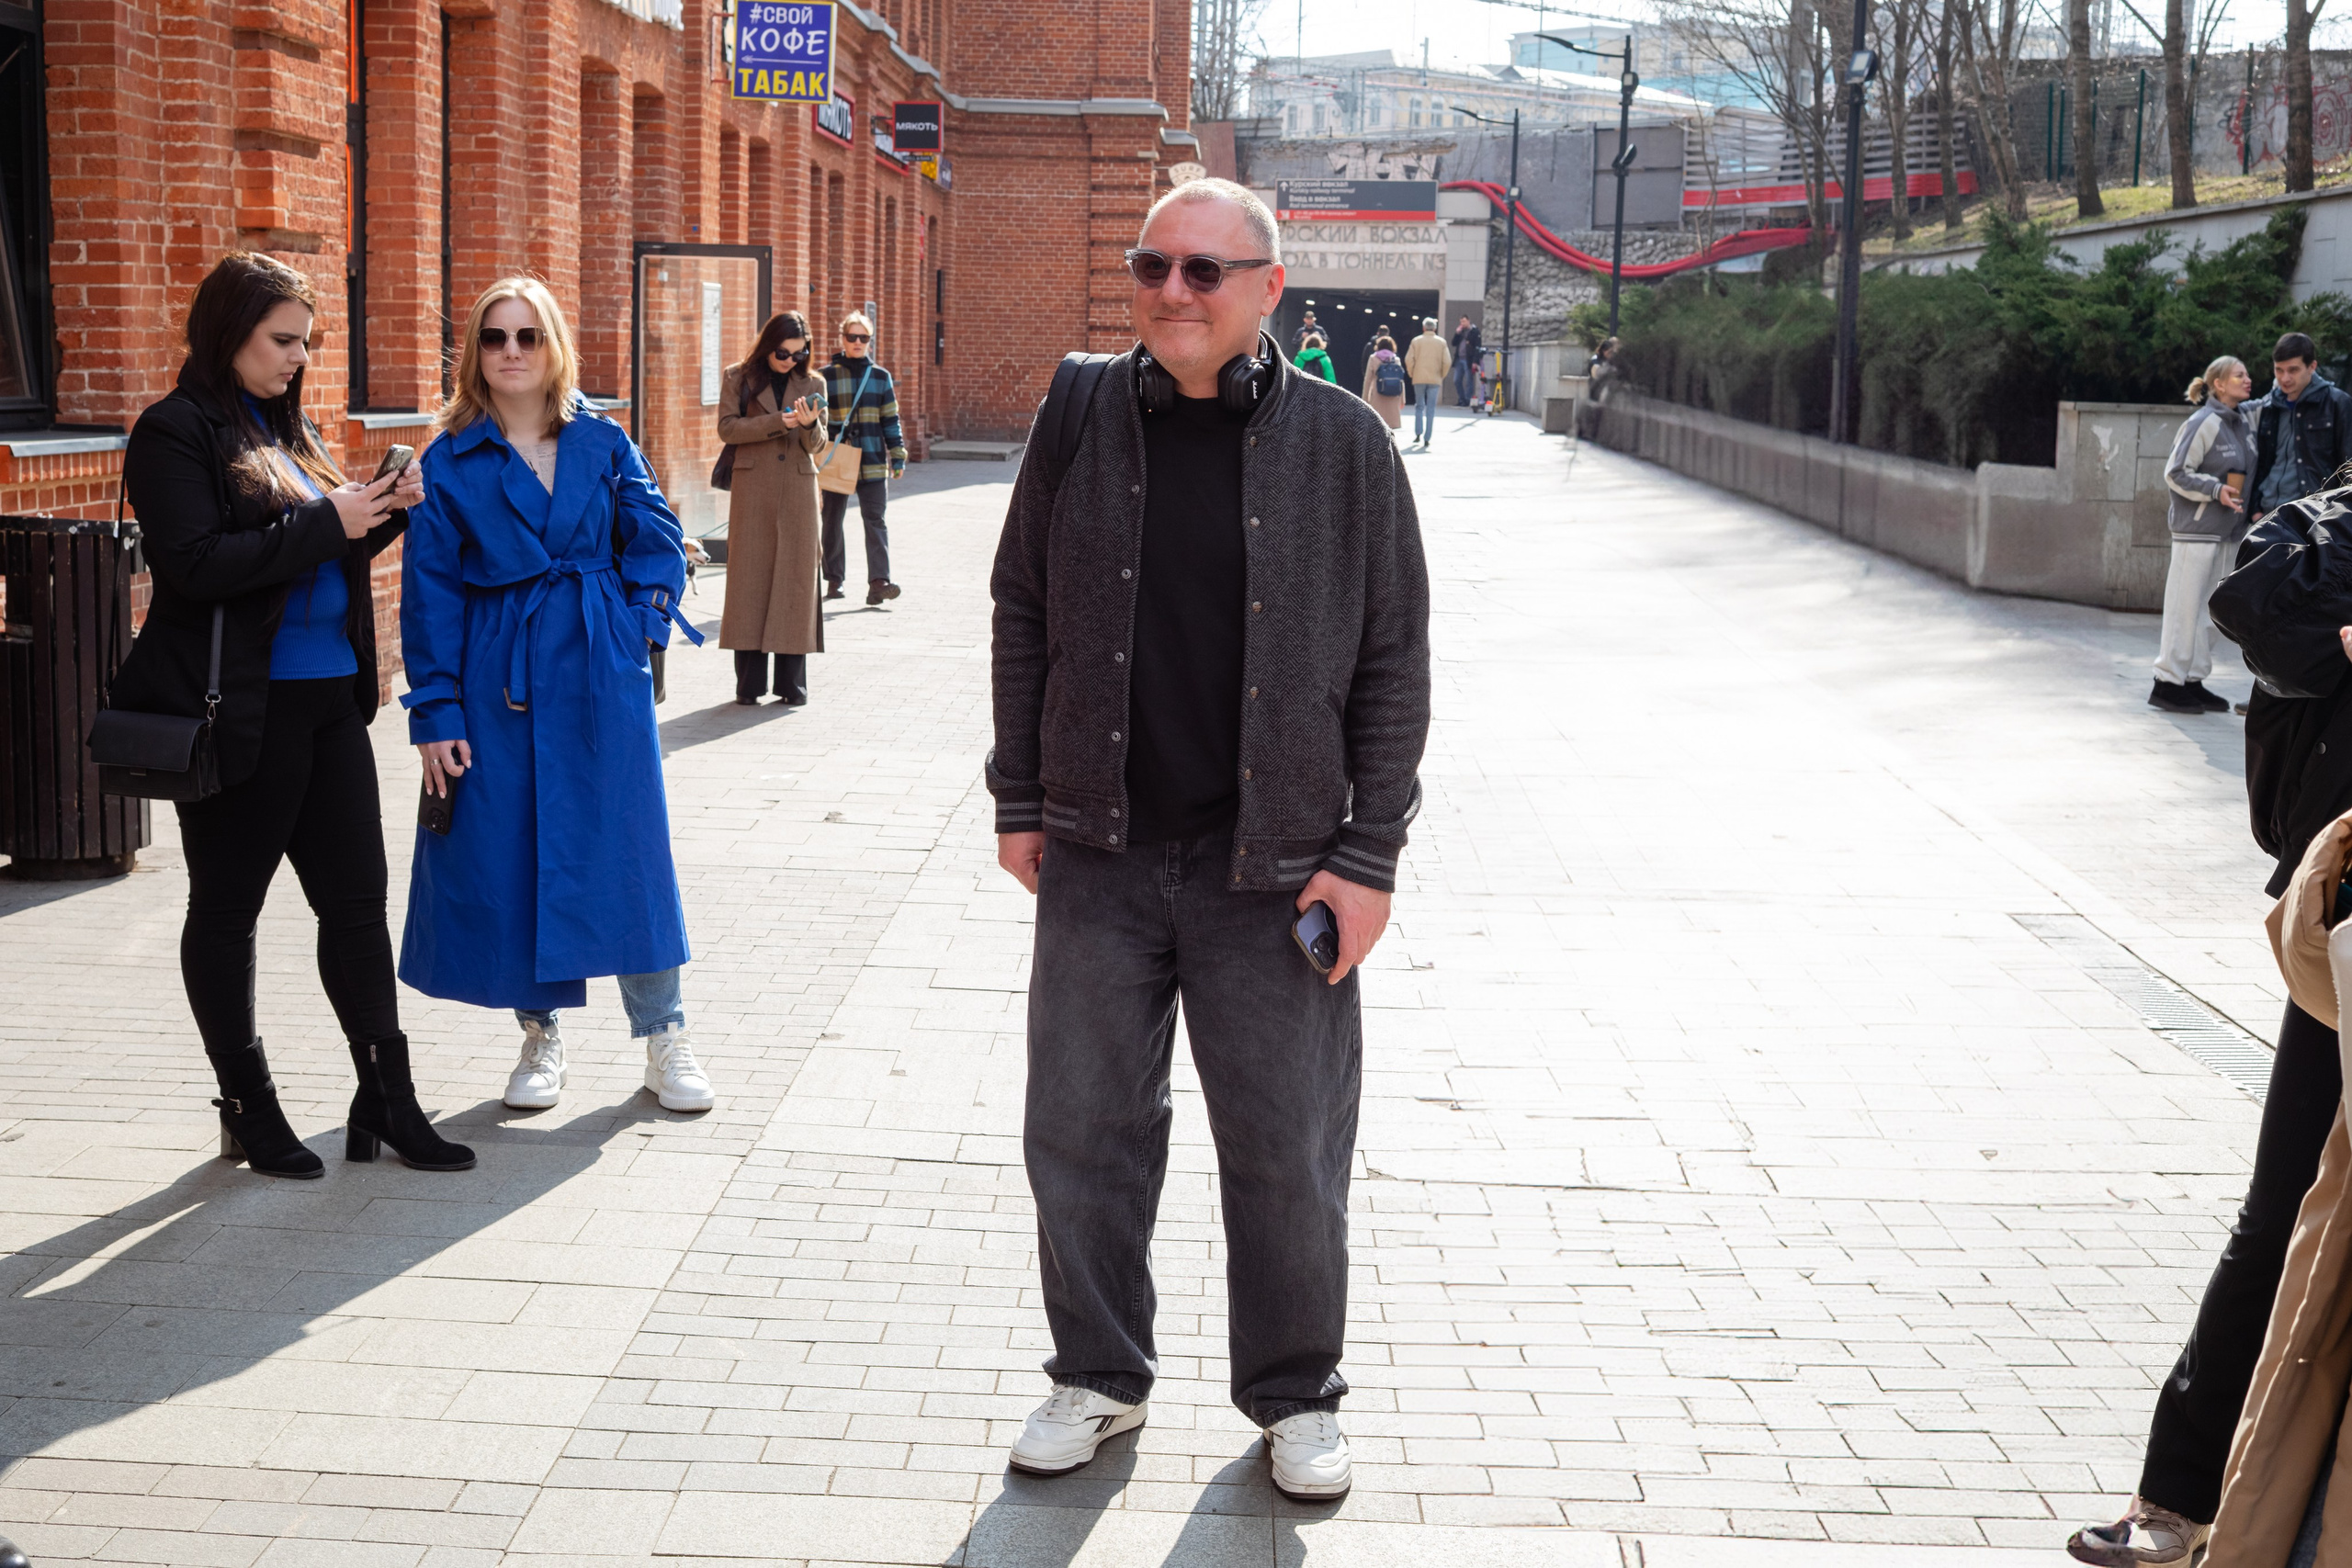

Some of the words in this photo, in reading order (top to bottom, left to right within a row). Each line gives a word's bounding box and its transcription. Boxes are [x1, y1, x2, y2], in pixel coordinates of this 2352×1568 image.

[749, 3, 813, 25] #СВОЙ
[741, 27, 827, 55] КОФЕ
[738, 68, 826, 97] ТАБАК
[895, 122, 938, 131] МЯКОТЬ
[1280, 225, 1357, 243] РСКИЙ
[1370, 226, 1448, 243] ВОКЗАЛ
[1280, 252, 1313, 267] ОД
[1318, 253, 1329, 268] В
[1337, 253, 1416, 270] ТОННЕЛЬ
